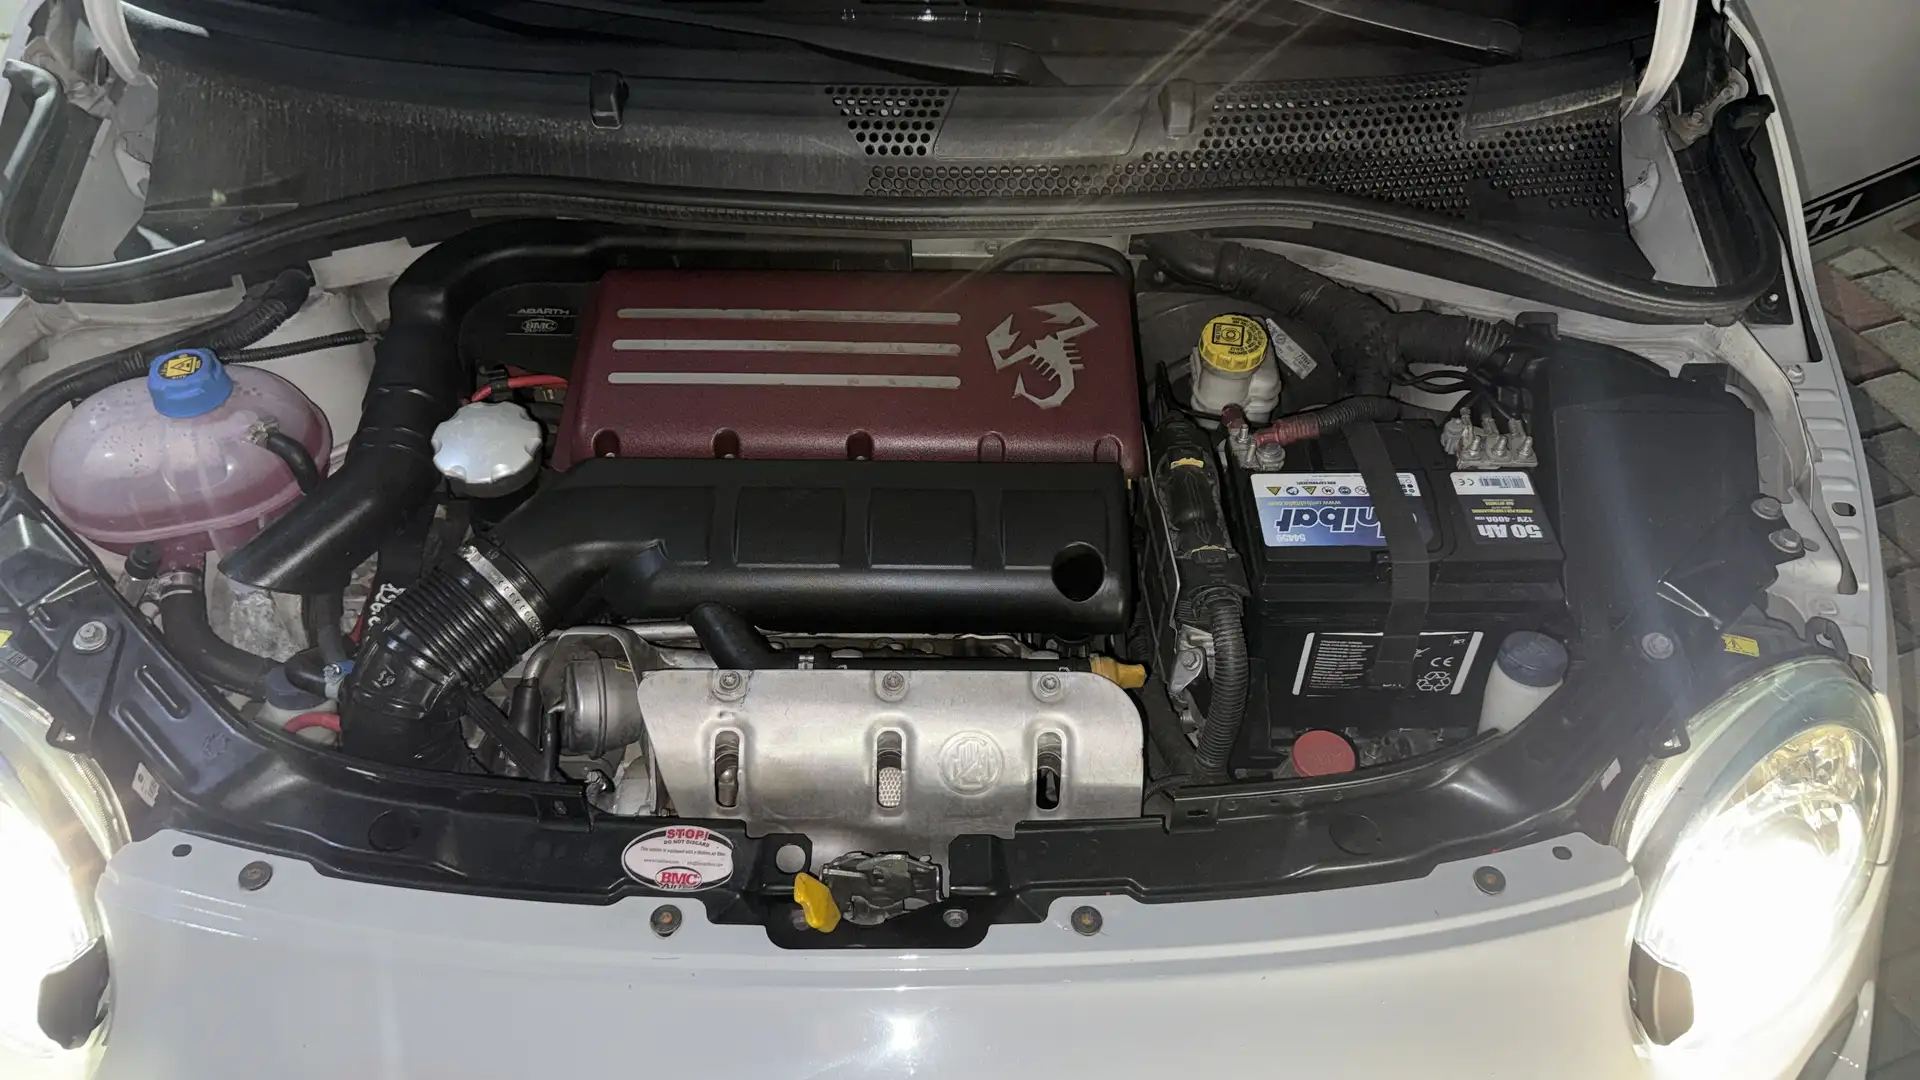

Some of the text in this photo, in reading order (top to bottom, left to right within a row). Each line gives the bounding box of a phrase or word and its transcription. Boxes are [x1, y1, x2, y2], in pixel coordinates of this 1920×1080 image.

[517, 307, 570, 315] ABARTH
[525, 321, 555, 330] BMC
[1477, 524, 1543, 538] 50 Ah
[667, 829, 709, 840] STOP!
[686, 840, 710, 848] DISCARD
[660, 872, 698, 886] BMC
